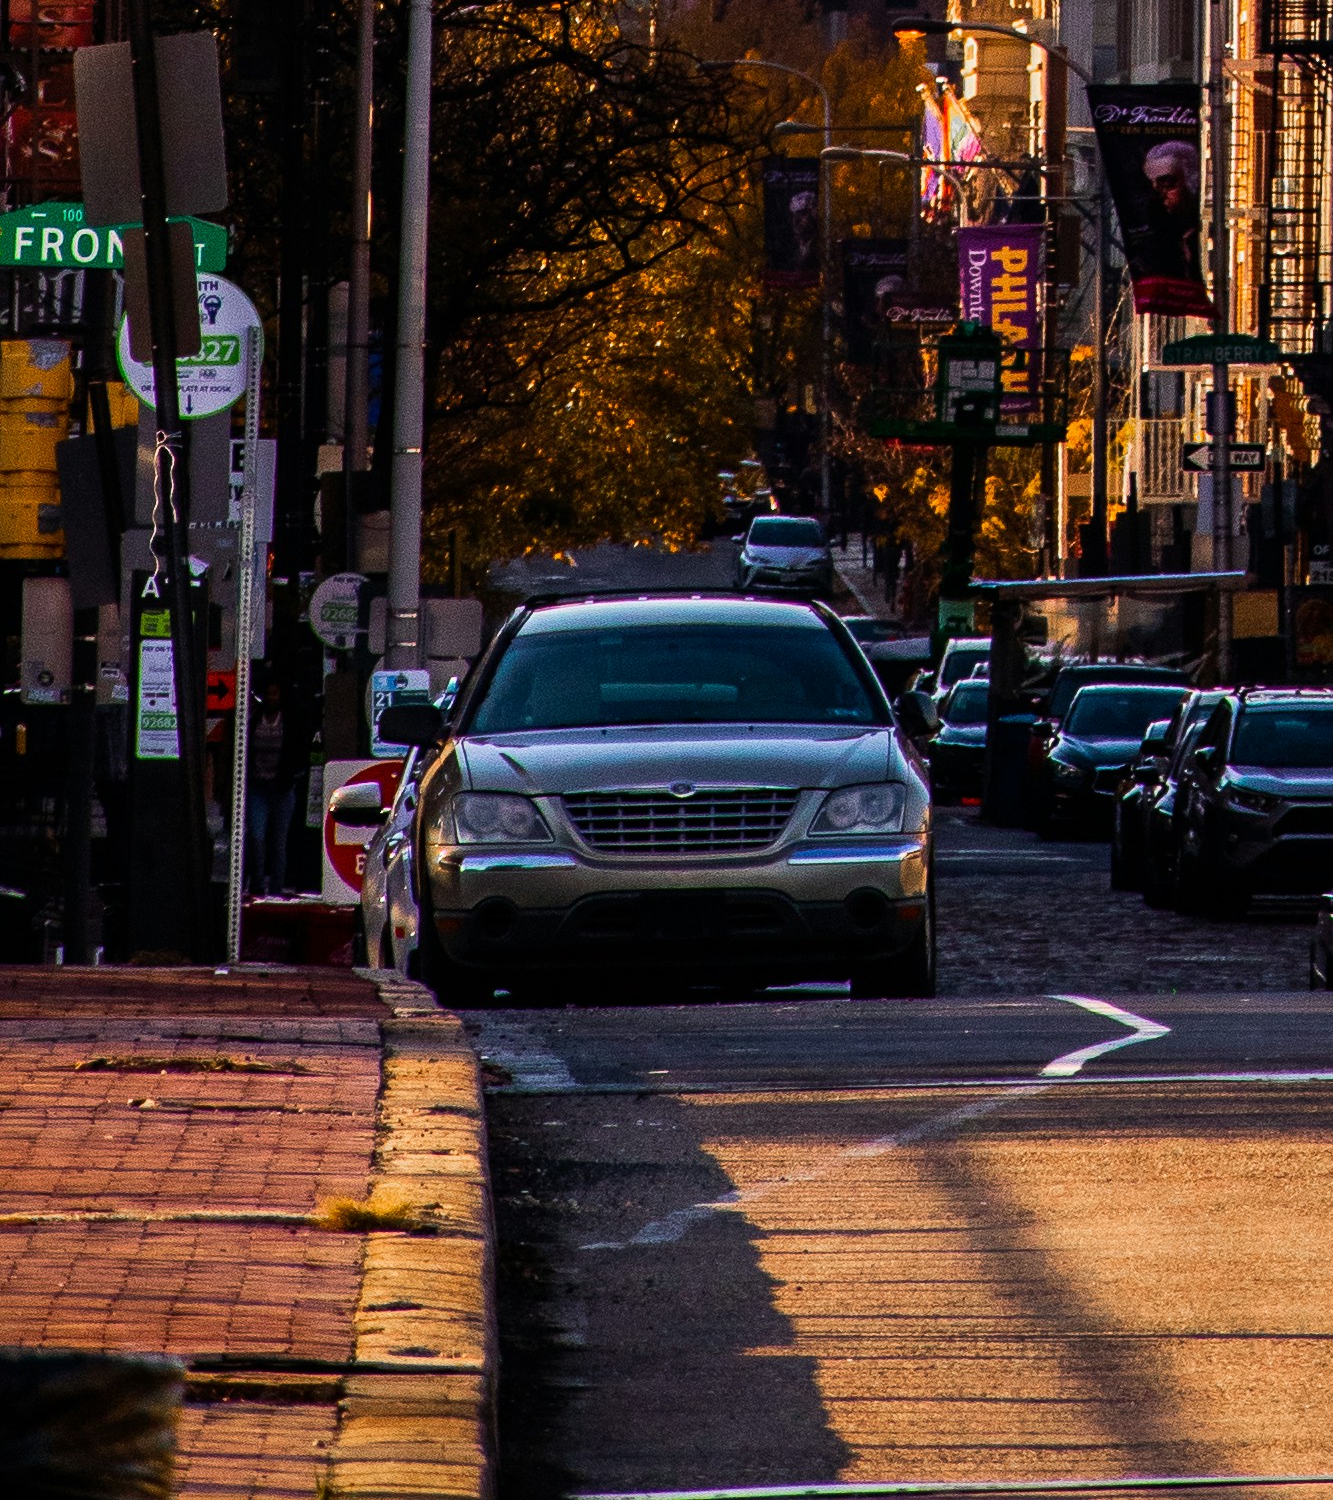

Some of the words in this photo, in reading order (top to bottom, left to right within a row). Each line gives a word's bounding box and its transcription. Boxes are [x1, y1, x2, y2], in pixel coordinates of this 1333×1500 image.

[1128, 104, 1198, 125] Franklin
[63, 209, 83, 222] 100
[14, 226, 124, 264] FRON
[194, 243, 205, 266] T
[198, 281, 218, 291] ITH
[968, 249, 987, 323] Downt
[1167, 345, 1262, 362] STRAWBERRY
[1233, 451, 1257, 463] WAY
[375, 691, 392, 707] 21
